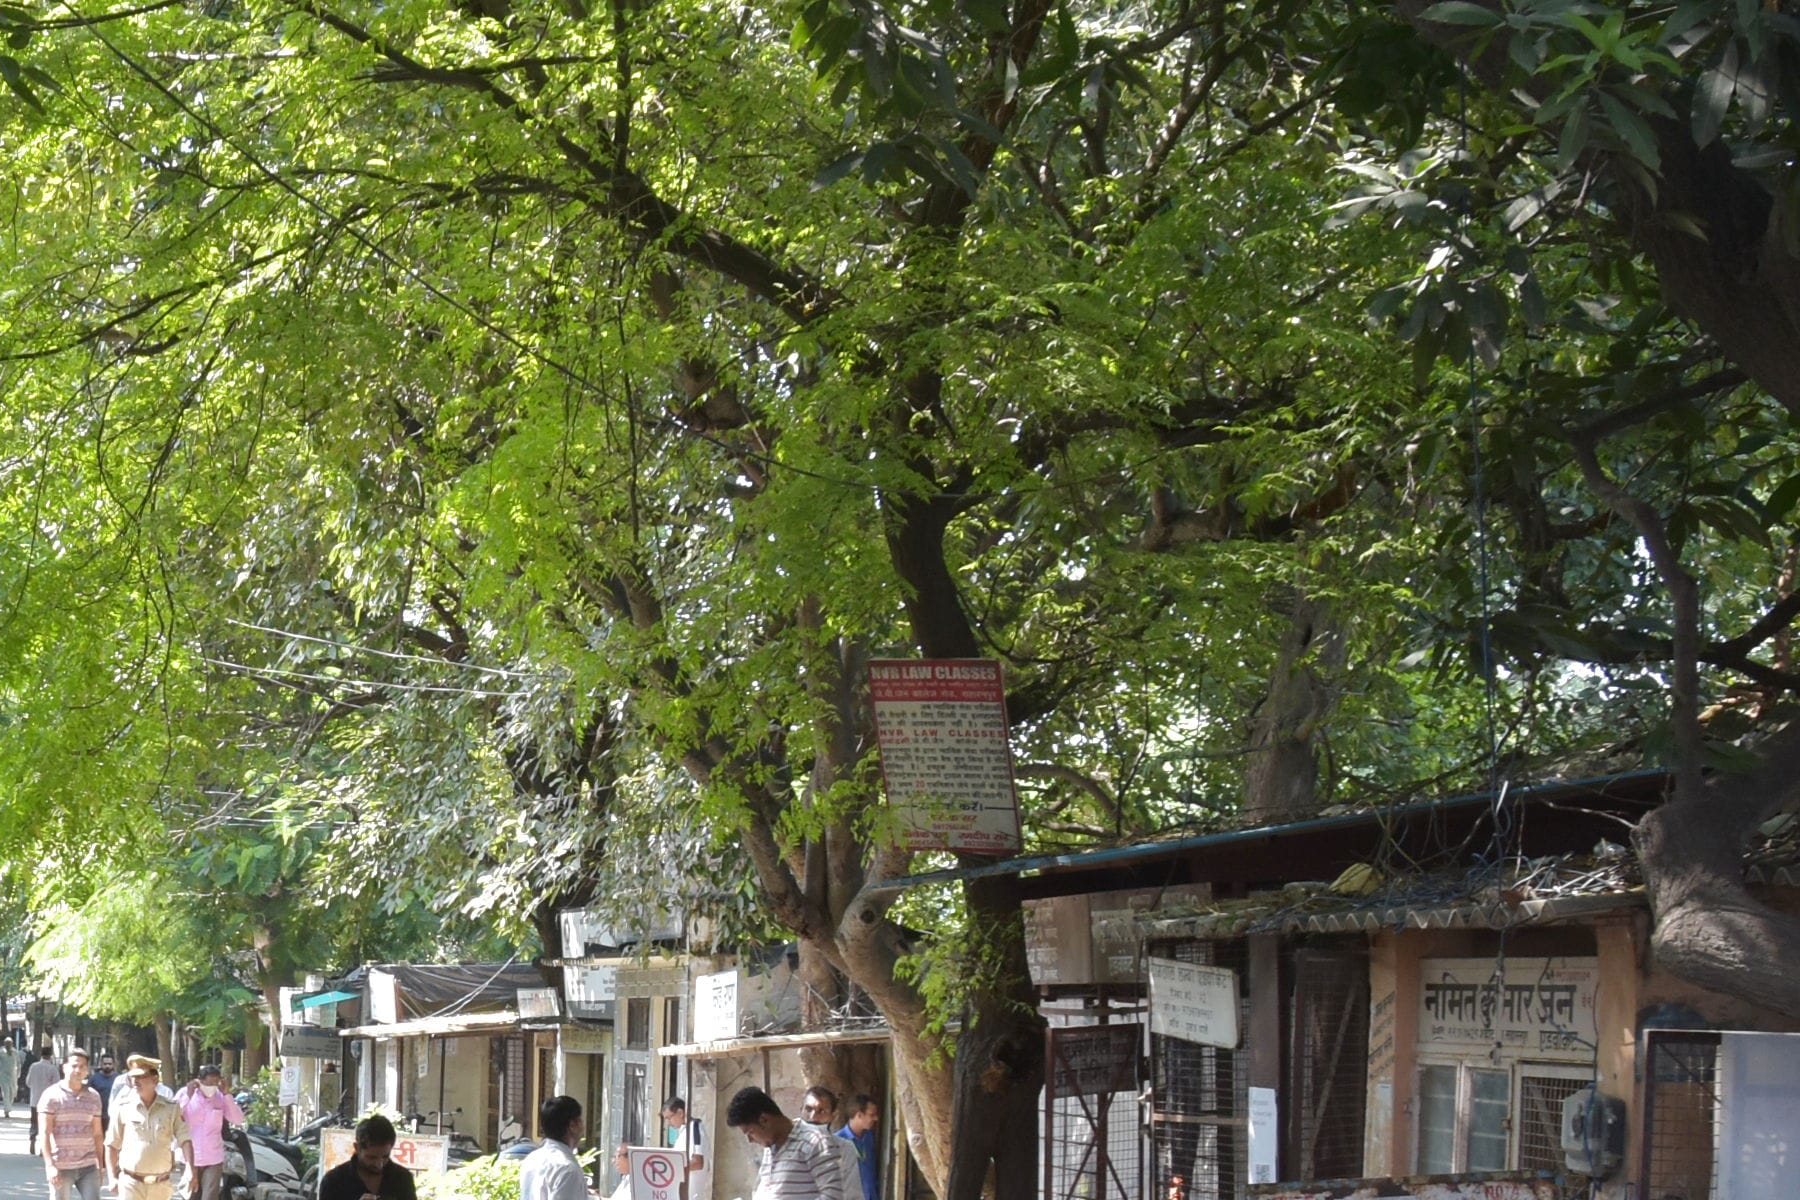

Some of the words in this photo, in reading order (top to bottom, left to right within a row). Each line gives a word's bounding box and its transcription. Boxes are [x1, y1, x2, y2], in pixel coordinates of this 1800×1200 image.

[870, 666, 899, 680] NVR
[902, 666, 932, 680] LAW
[935, 666, 997, 680] CLASSES
[914, 729, 938, 737] LAW
[948, 729, 1007, 738] CLASSES
[1425, 971, 1478, 1022] नमित
[652, 1190, 668, 1200] NO
